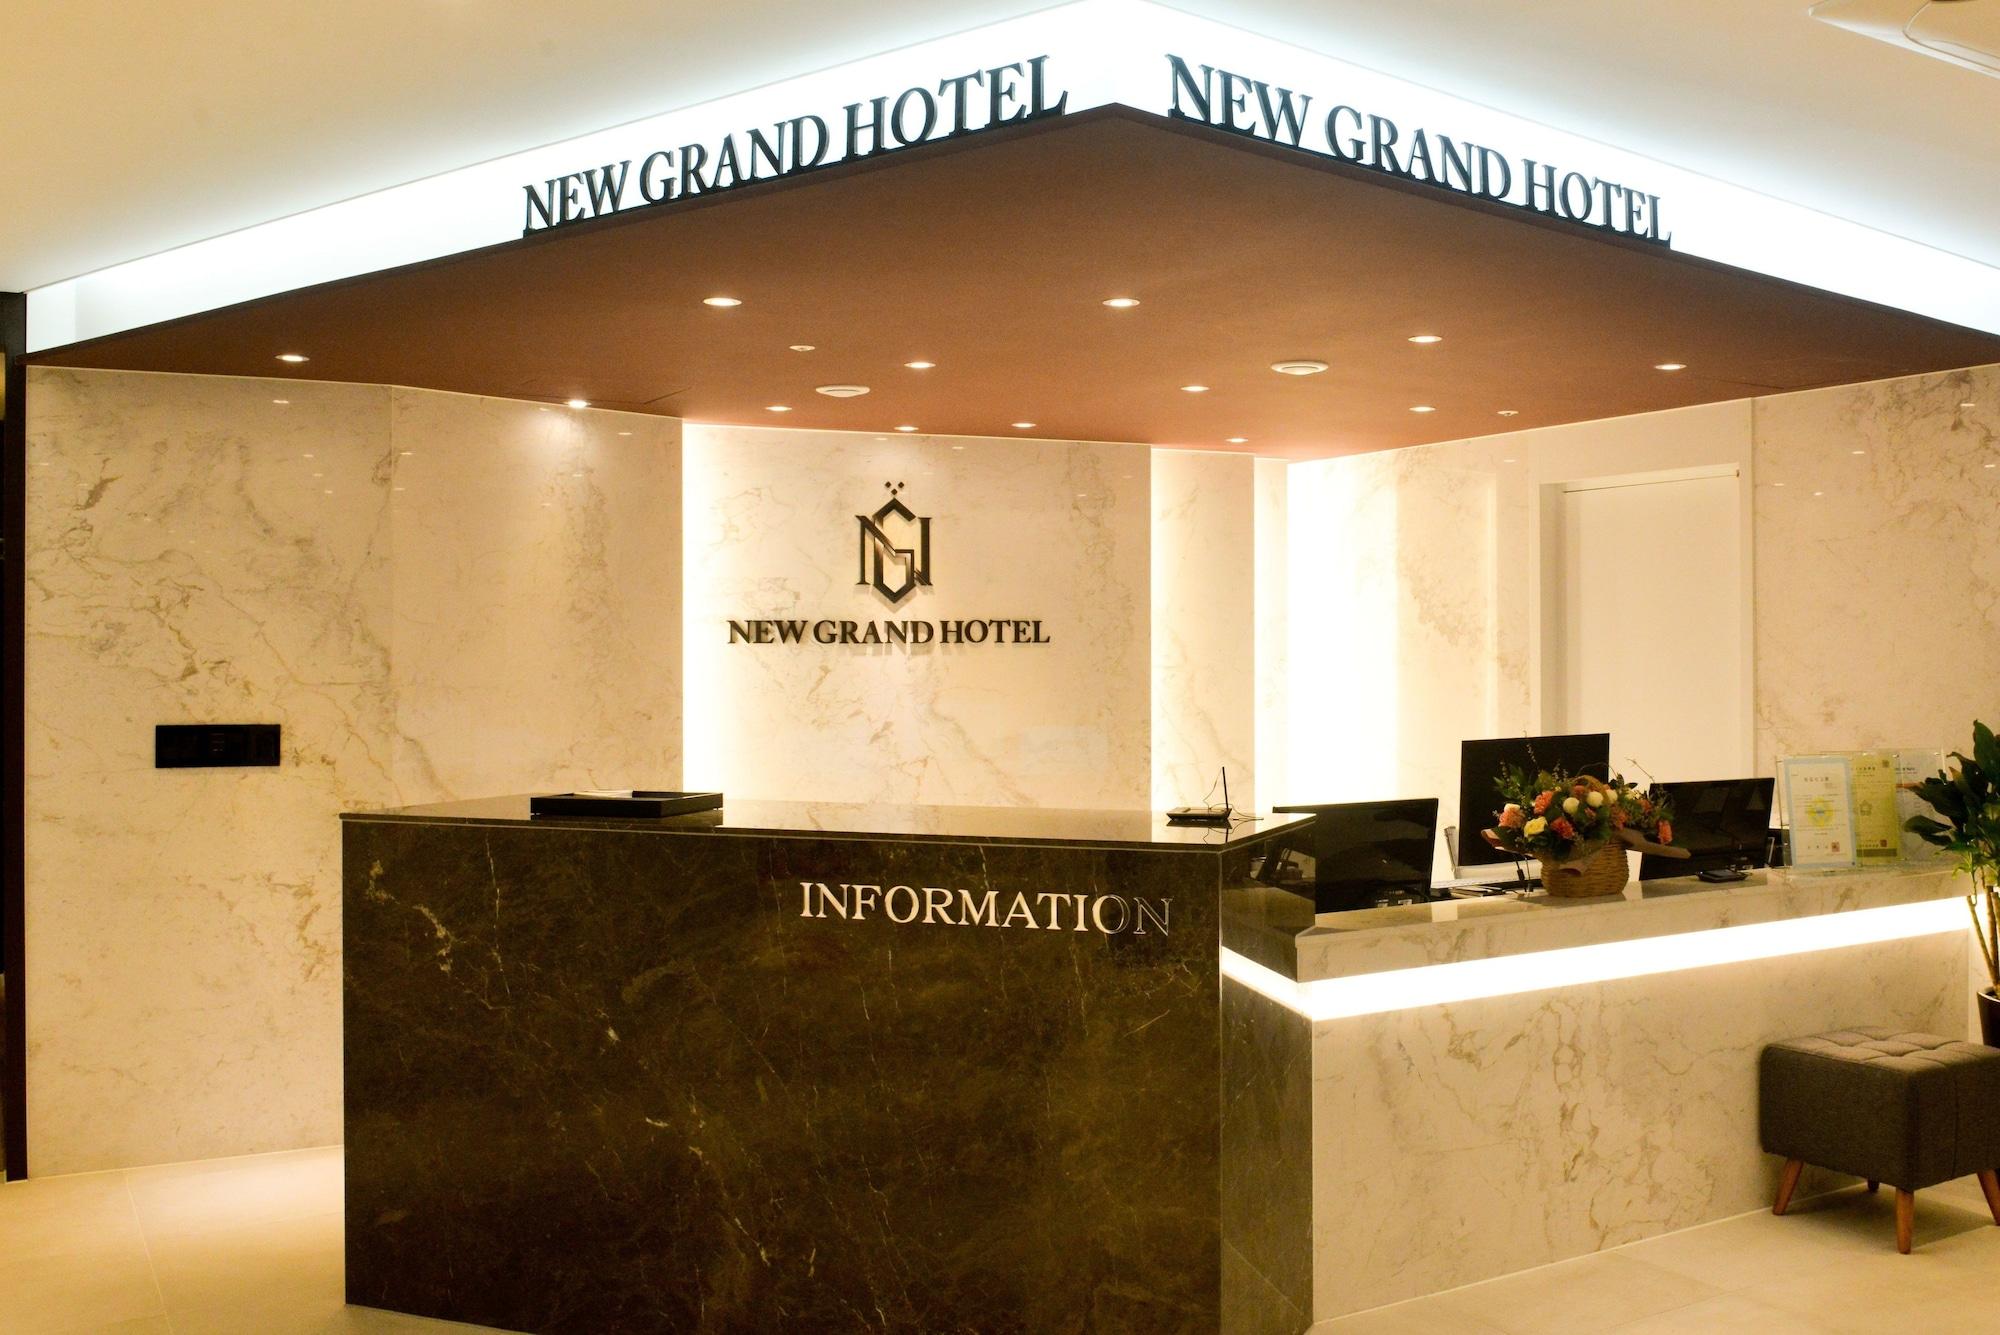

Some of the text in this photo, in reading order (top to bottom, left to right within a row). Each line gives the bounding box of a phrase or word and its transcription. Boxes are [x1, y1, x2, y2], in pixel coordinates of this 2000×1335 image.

[523, 54, 1068, 235] NEW GRAND HOTEL
[1165, 53, 1671, 246] NEW GRAND HOTEL
[727, 619, 1051, 644] NEW GRAND HOTEL
[799, 881, 1173, 937] INFORMATION
